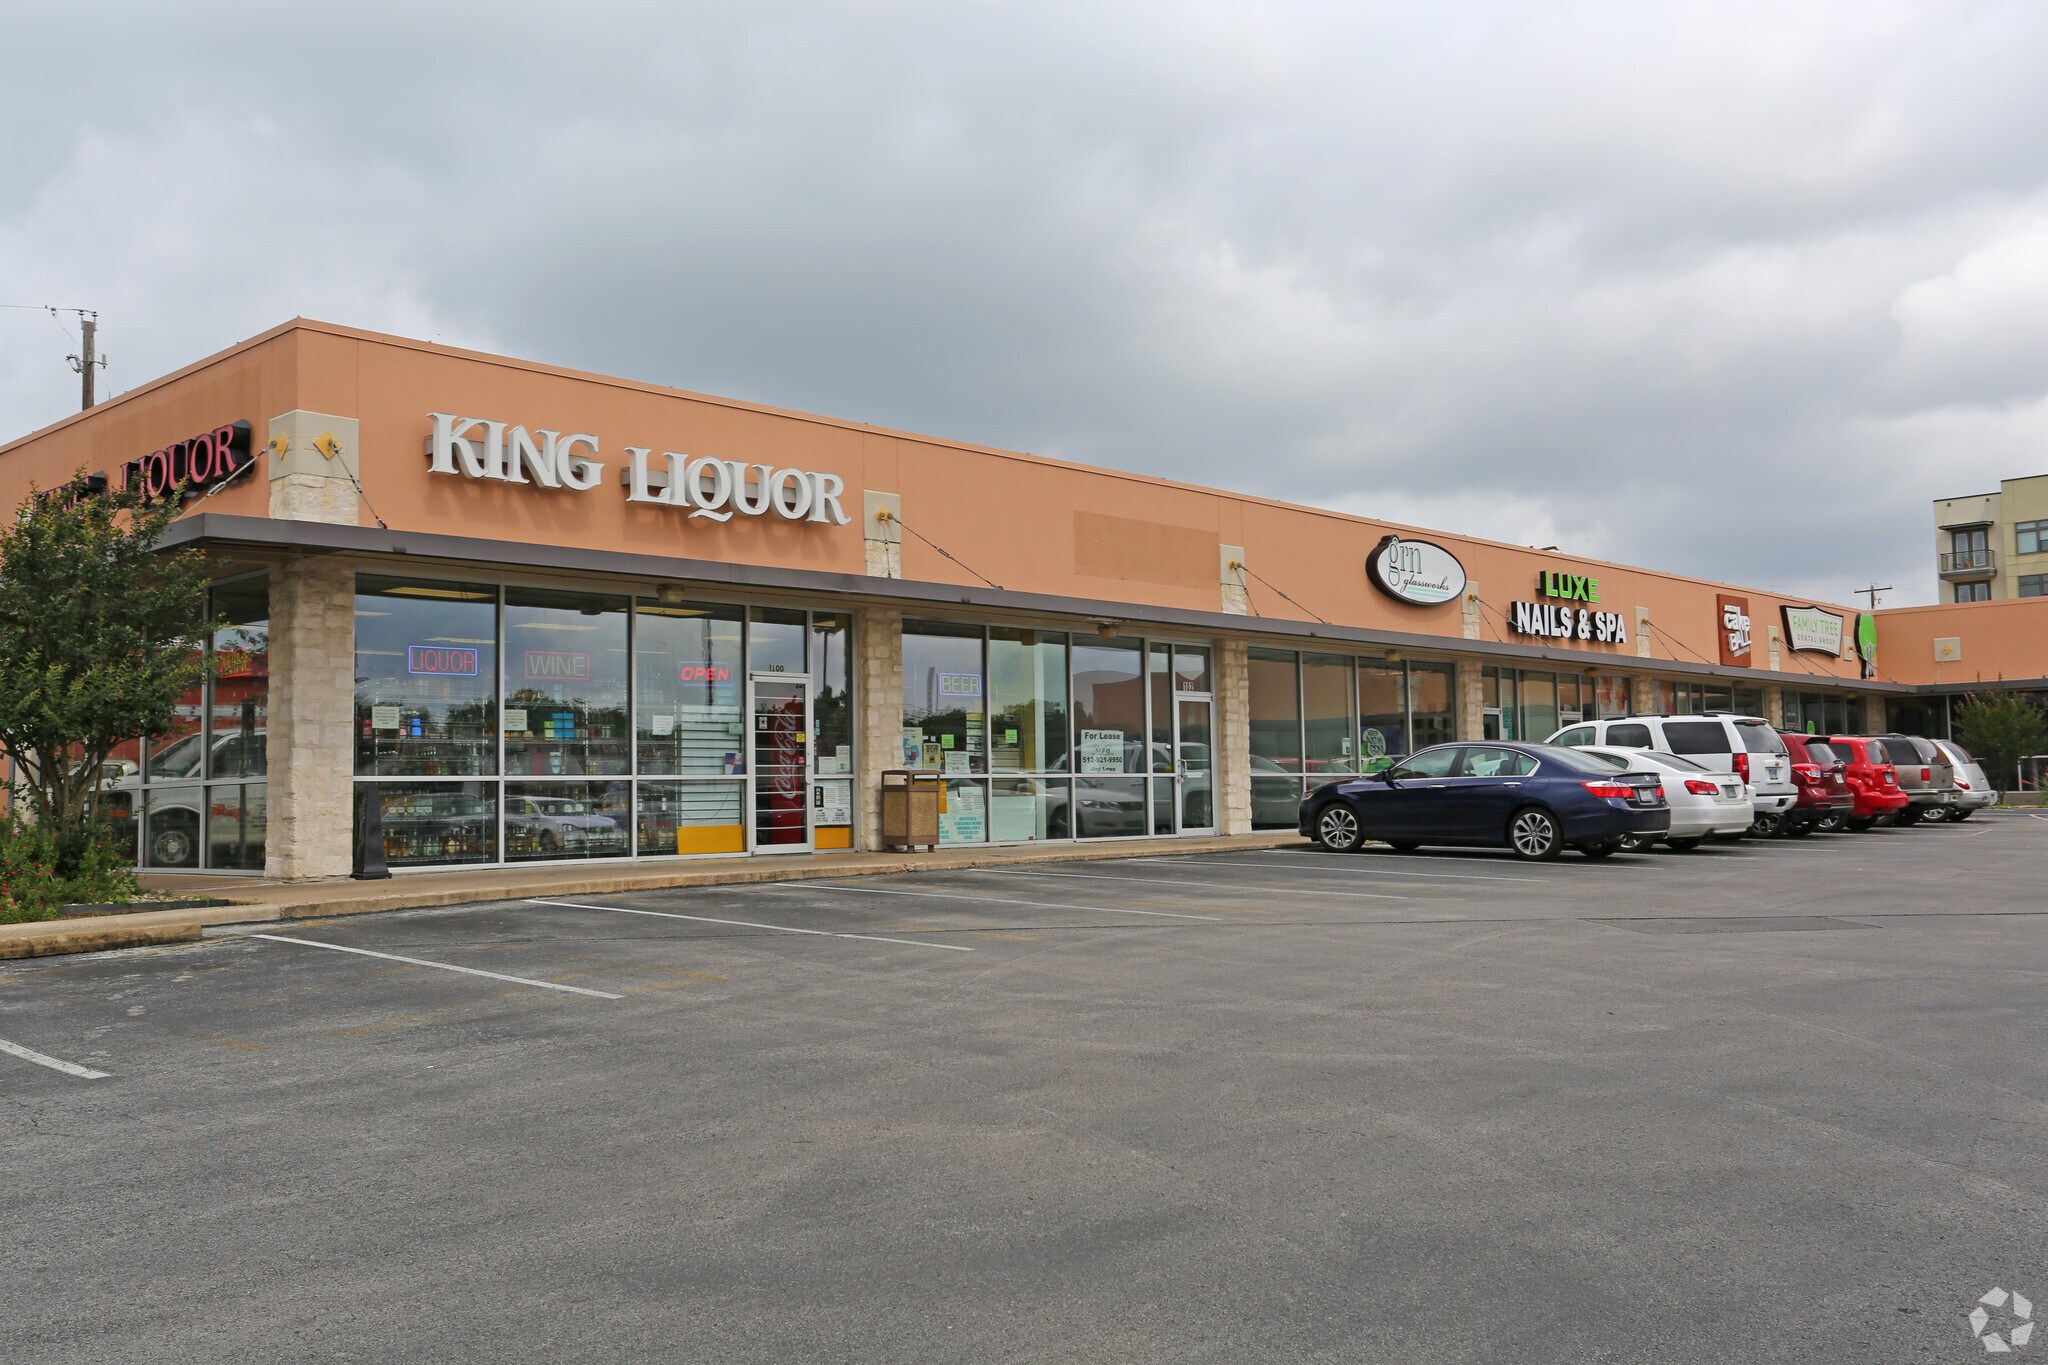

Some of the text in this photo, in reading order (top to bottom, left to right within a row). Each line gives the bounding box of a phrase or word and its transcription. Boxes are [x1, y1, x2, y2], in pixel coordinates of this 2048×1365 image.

[426, 411, 852, 526] KING LIQUOR
[1400, 575, 1450, 593] glassworks
[1542, 570, 1601, 603] LUXE
[1514, 601, 1627, 644] NAILS & SPA
[1793, 615, 1839, 637] FAMILY TREE
[1728, 630, 1752, 652] BALL
[1797, 633, 1836, 645] DENTAL GROUP
[411, 648, 475, 673] LIQUOR
[529, 654, 586, 677] WINE
[769, 664, 785, 672] 1100
[680, 666, 730, 681] OPEN
[942, 675, 980, 693] BEER
[1084, 732, 1121, 740] For Lease
